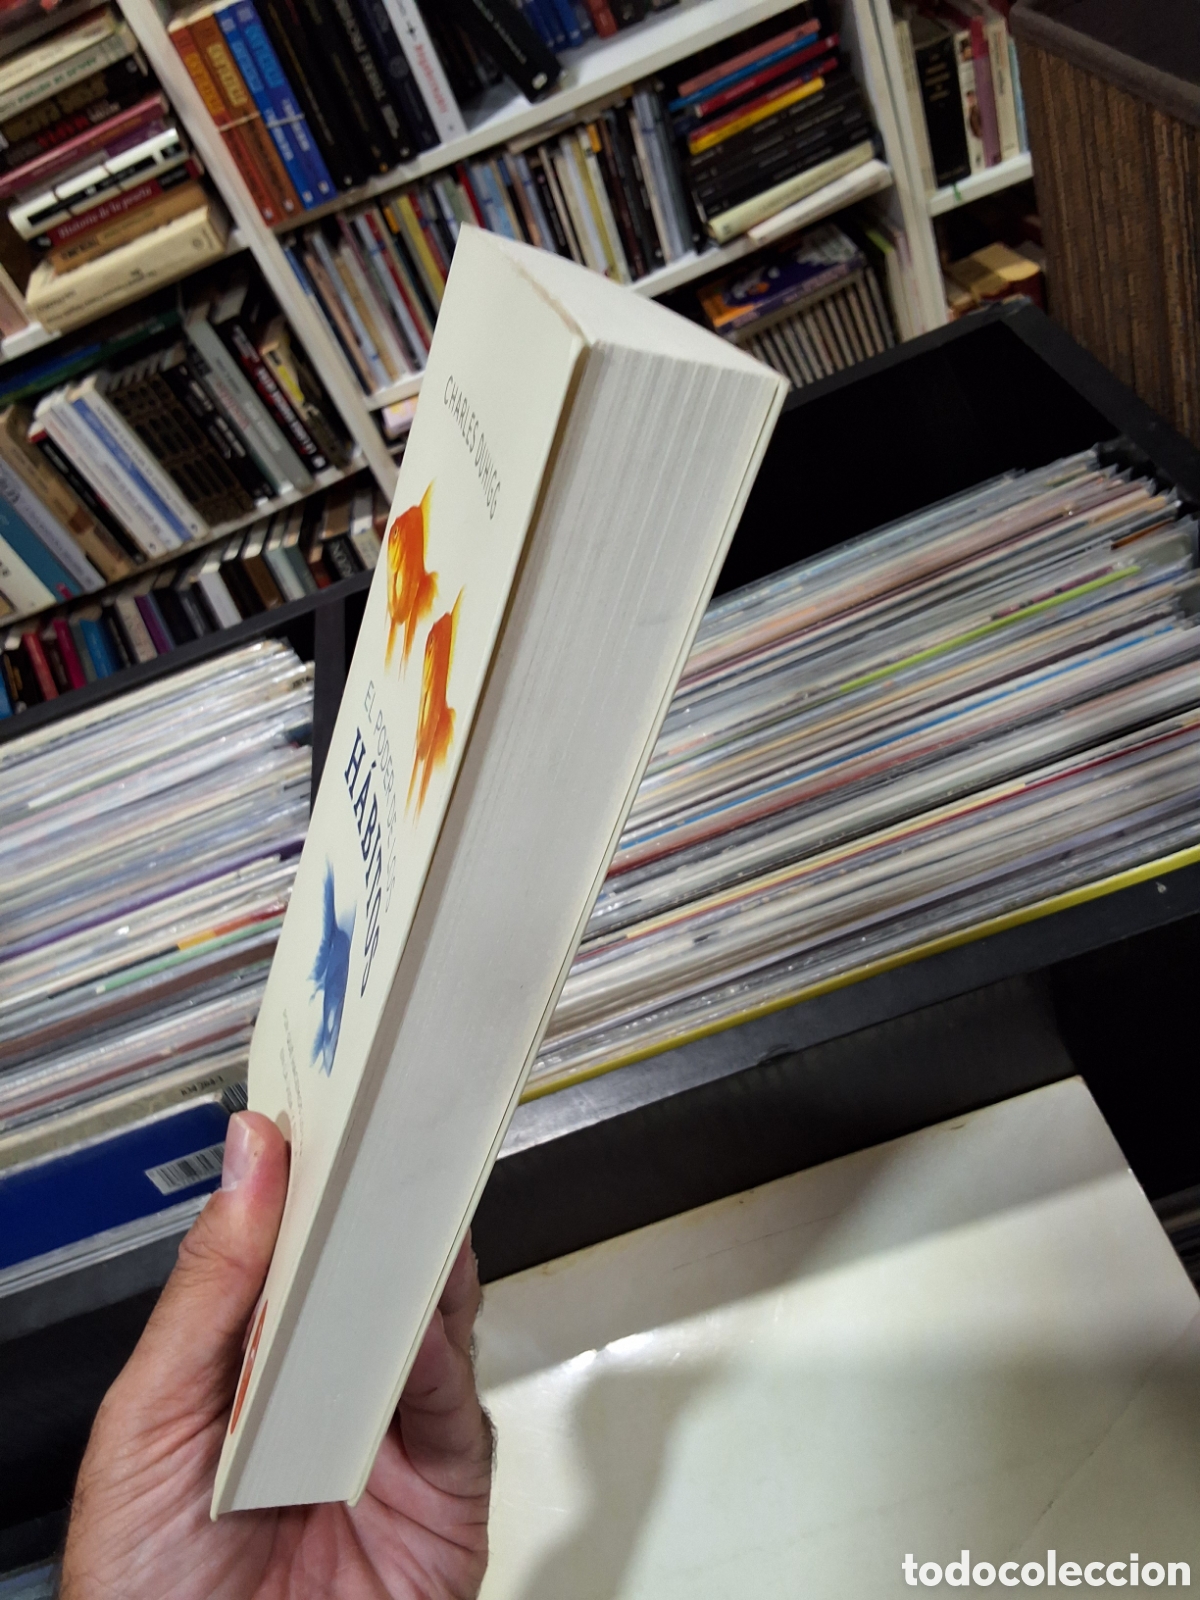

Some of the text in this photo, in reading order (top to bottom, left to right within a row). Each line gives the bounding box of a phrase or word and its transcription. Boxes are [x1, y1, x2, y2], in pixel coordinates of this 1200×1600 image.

[444, 374, 501, 521] CHARLES DUHIGG
[364, 680, 377, 724] EL
[373, 708, 395, 807] PODER
[344, 725, 383, 998] HÁBITOS
